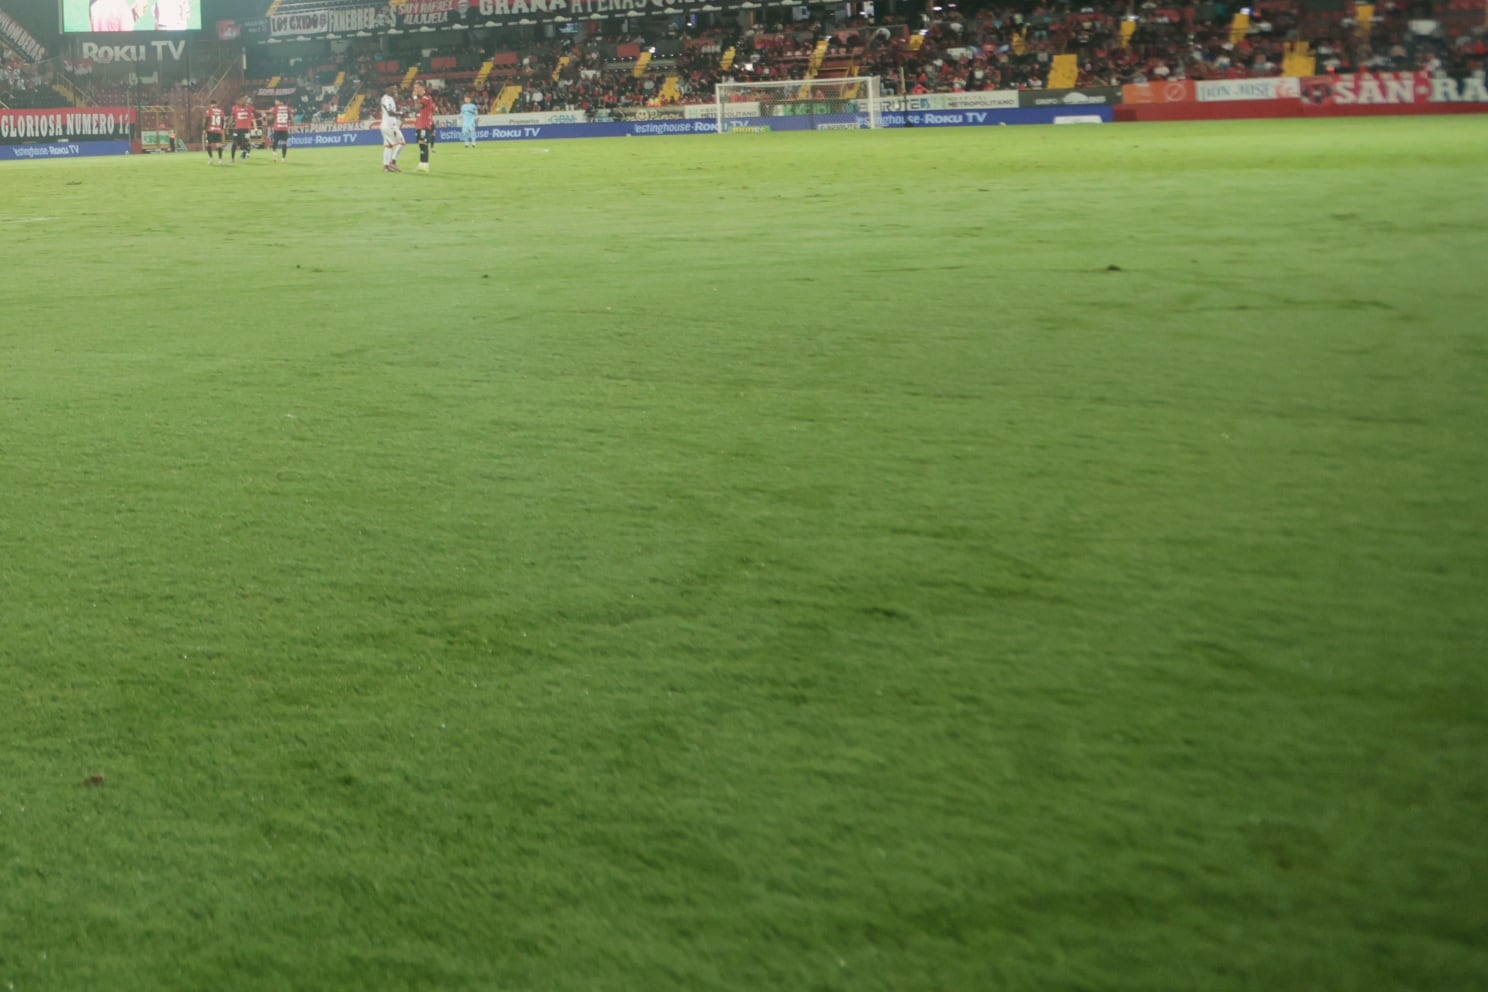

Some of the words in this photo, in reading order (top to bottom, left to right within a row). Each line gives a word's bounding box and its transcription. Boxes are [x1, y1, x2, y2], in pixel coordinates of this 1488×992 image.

[82, 42, 146, 62] Roku
[151, 40, 185, 61] TV
[1334, 79, 1414, 104] SAN
[1, 114, 63, 138] GLORIOSA
[66, 113, 114, 135] NUMERO
[965, 112, 987, 123] TV
[343, 133, 357, 142] TV
[524, 127, 540, 137] TV
